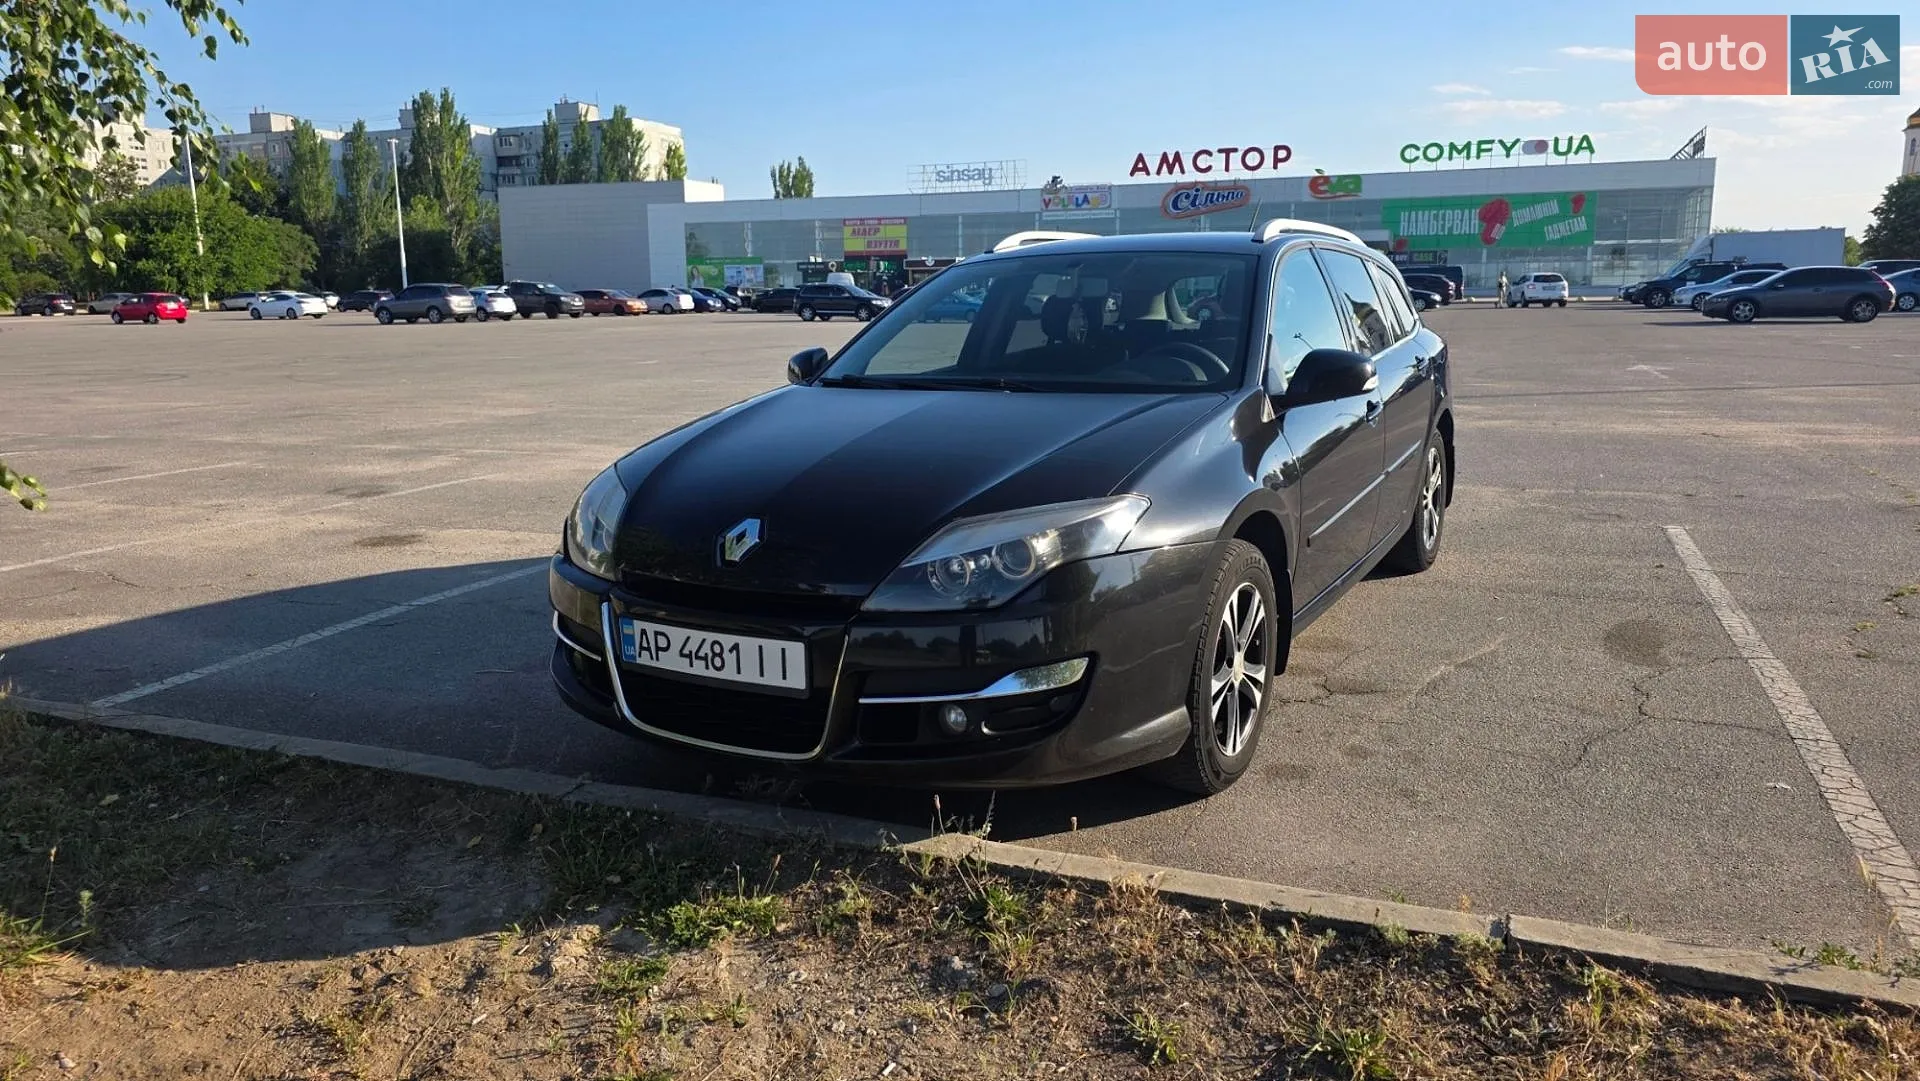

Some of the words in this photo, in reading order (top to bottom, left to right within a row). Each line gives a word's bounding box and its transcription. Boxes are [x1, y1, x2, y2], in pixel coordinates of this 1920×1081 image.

[1129, 144, 1292, 177] АМСТОР
[1400, 138, 1520, 164] COMFY
[1553, 134, 1596, 157] UA
[936, 165, 993, 186] sinsay
[1170, 186, 1245, 213] Сільпо
[1400, 208, 1479, 237] НАМБЕРВАН
[624, 645, 636, 656] UA
[637, 628, 671, 662] AP
[679, 635, 741, 675] 4481
